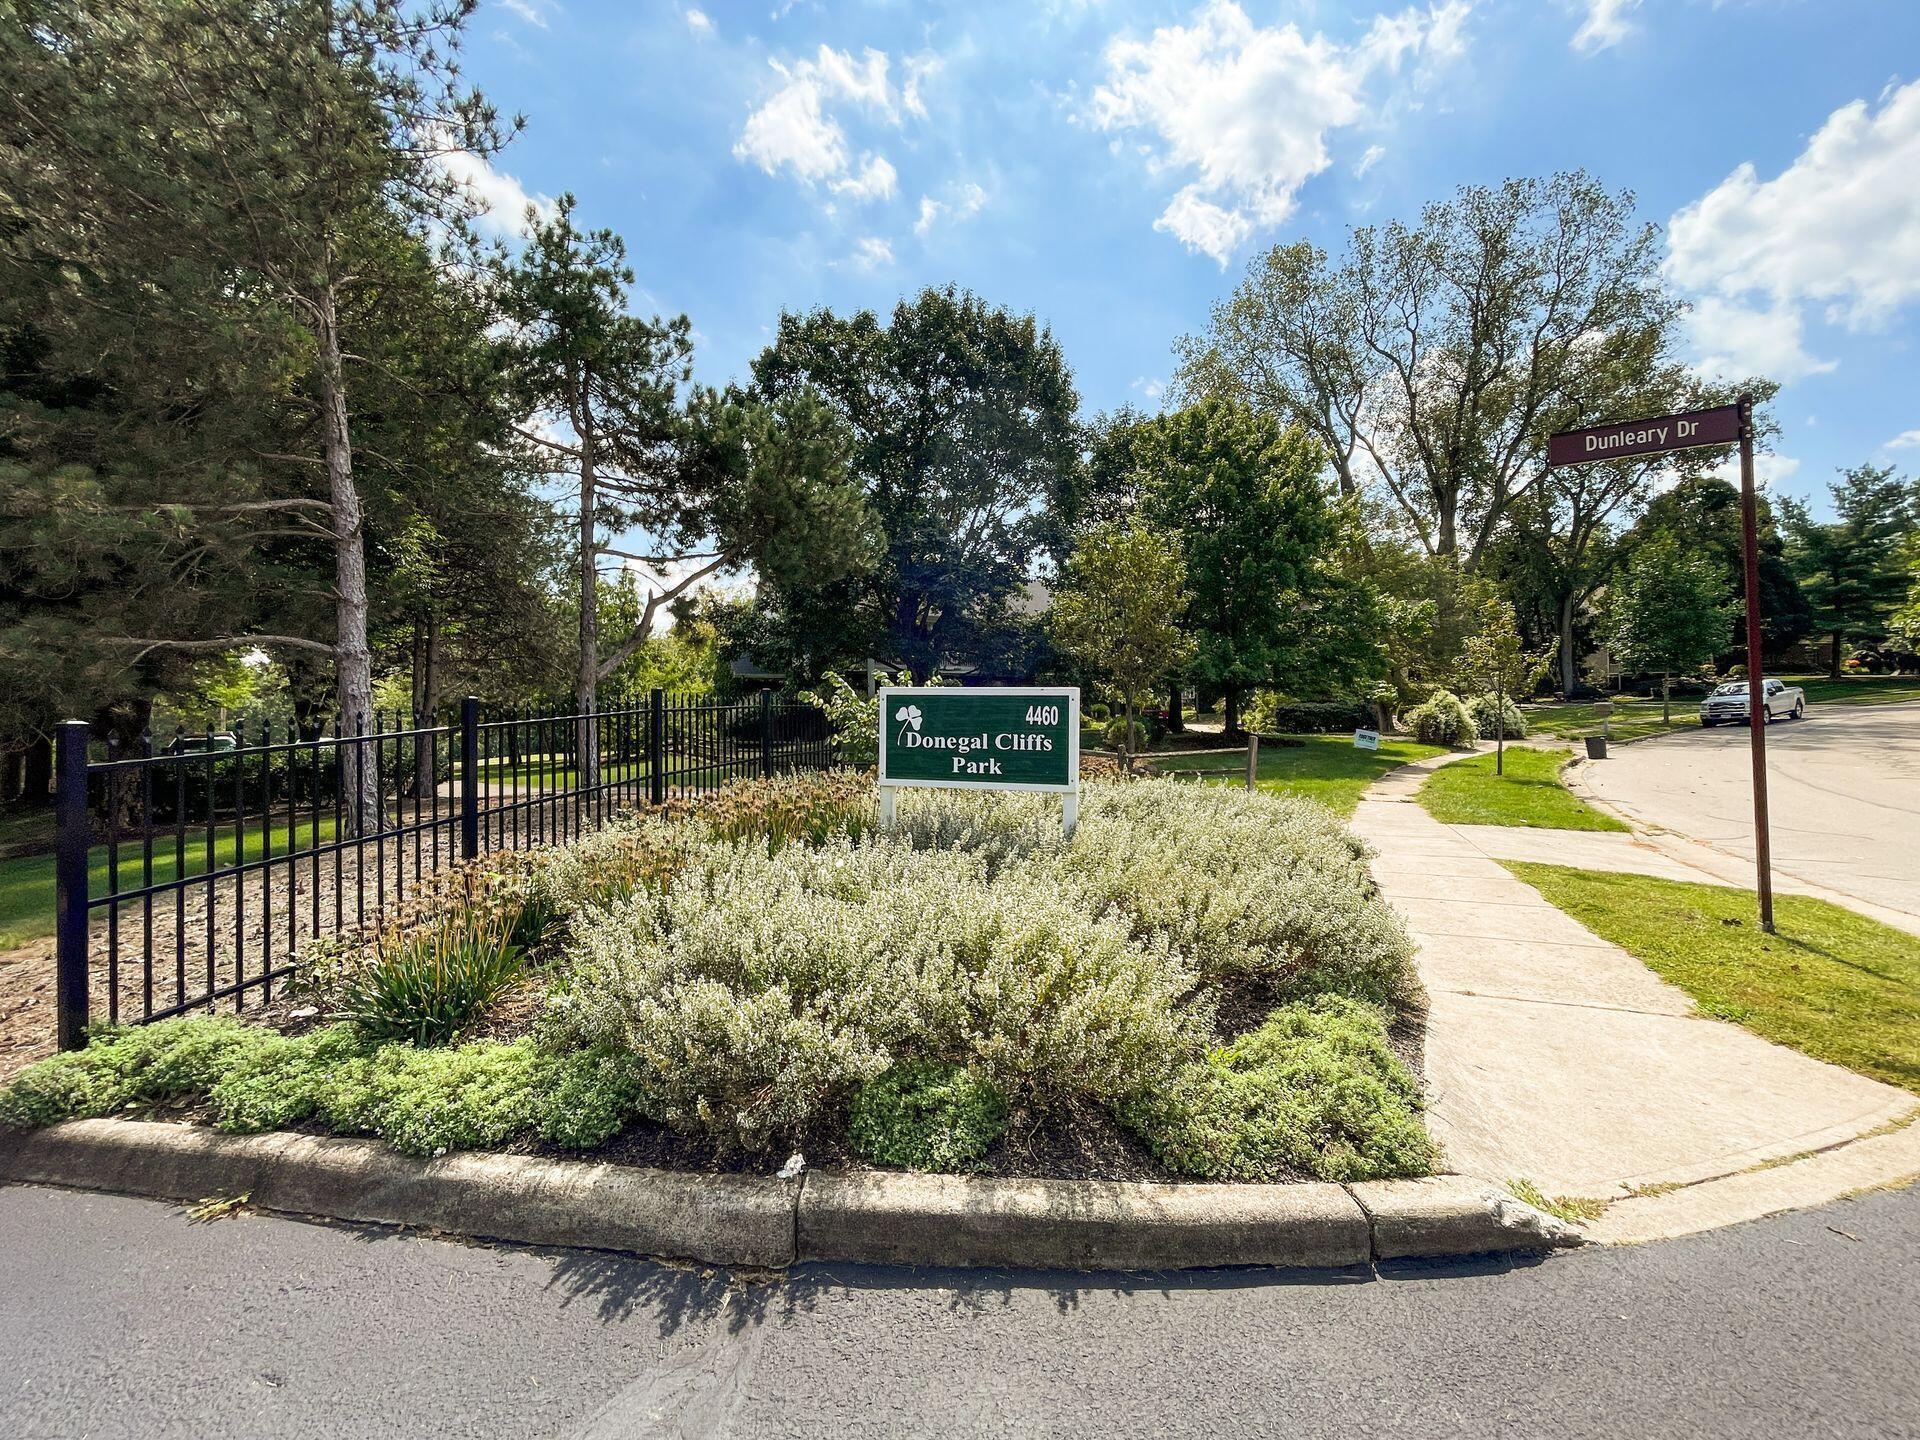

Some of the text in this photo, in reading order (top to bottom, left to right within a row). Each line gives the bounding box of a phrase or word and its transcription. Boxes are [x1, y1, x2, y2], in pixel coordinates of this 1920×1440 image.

[1585, 421, 1699, 452] Dunleary Dr
[1025, 705, 1059, 726] 4460
[906, 732, 1053, 753] Donegal Cliffs
[951, 756, 1002, 775] Park
